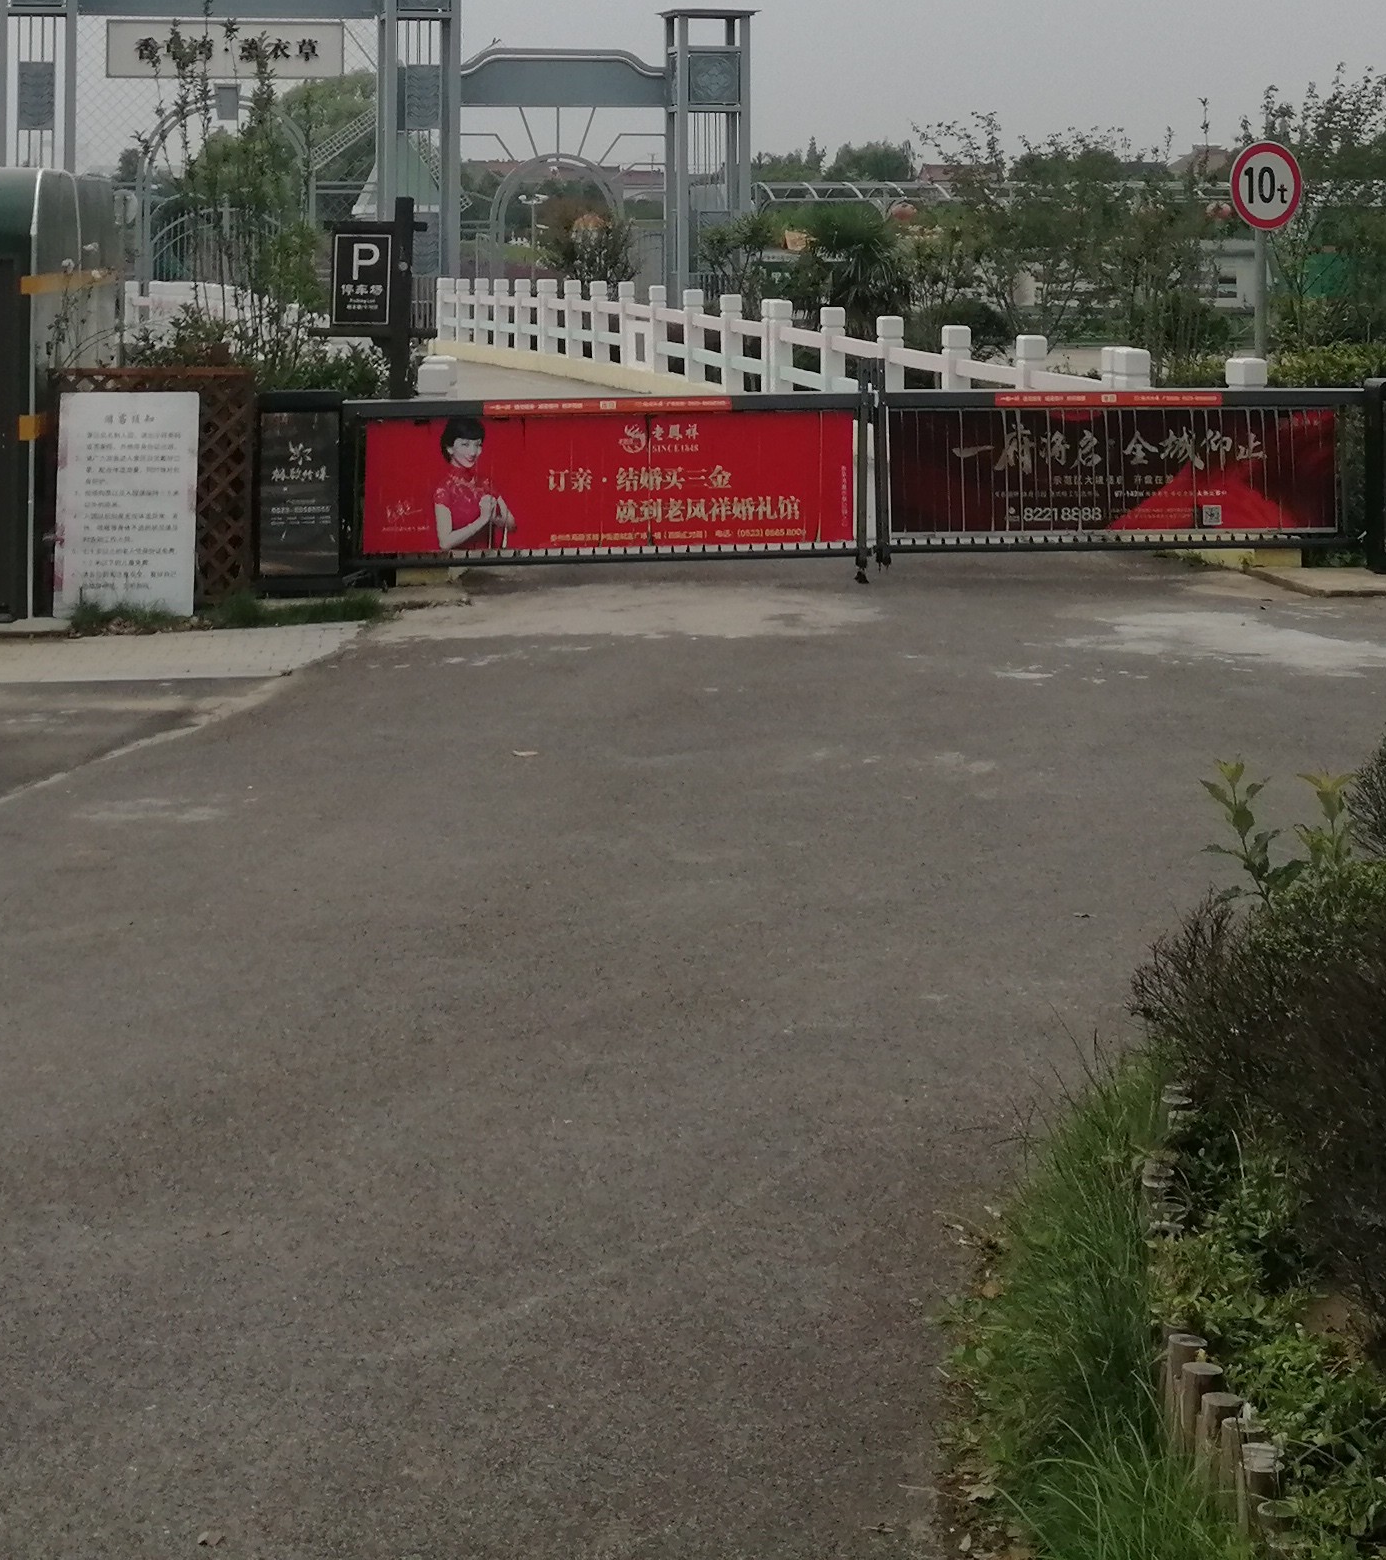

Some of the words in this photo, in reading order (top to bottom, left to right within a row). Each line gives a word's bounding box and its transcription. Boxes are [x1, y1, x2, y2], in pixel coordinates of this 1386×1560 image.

[1244, 166, 1288, 204] 10t
[353, 243, 380, 280] P
[615, 495, 801, 523] 就到老凤祥婚礼馆
